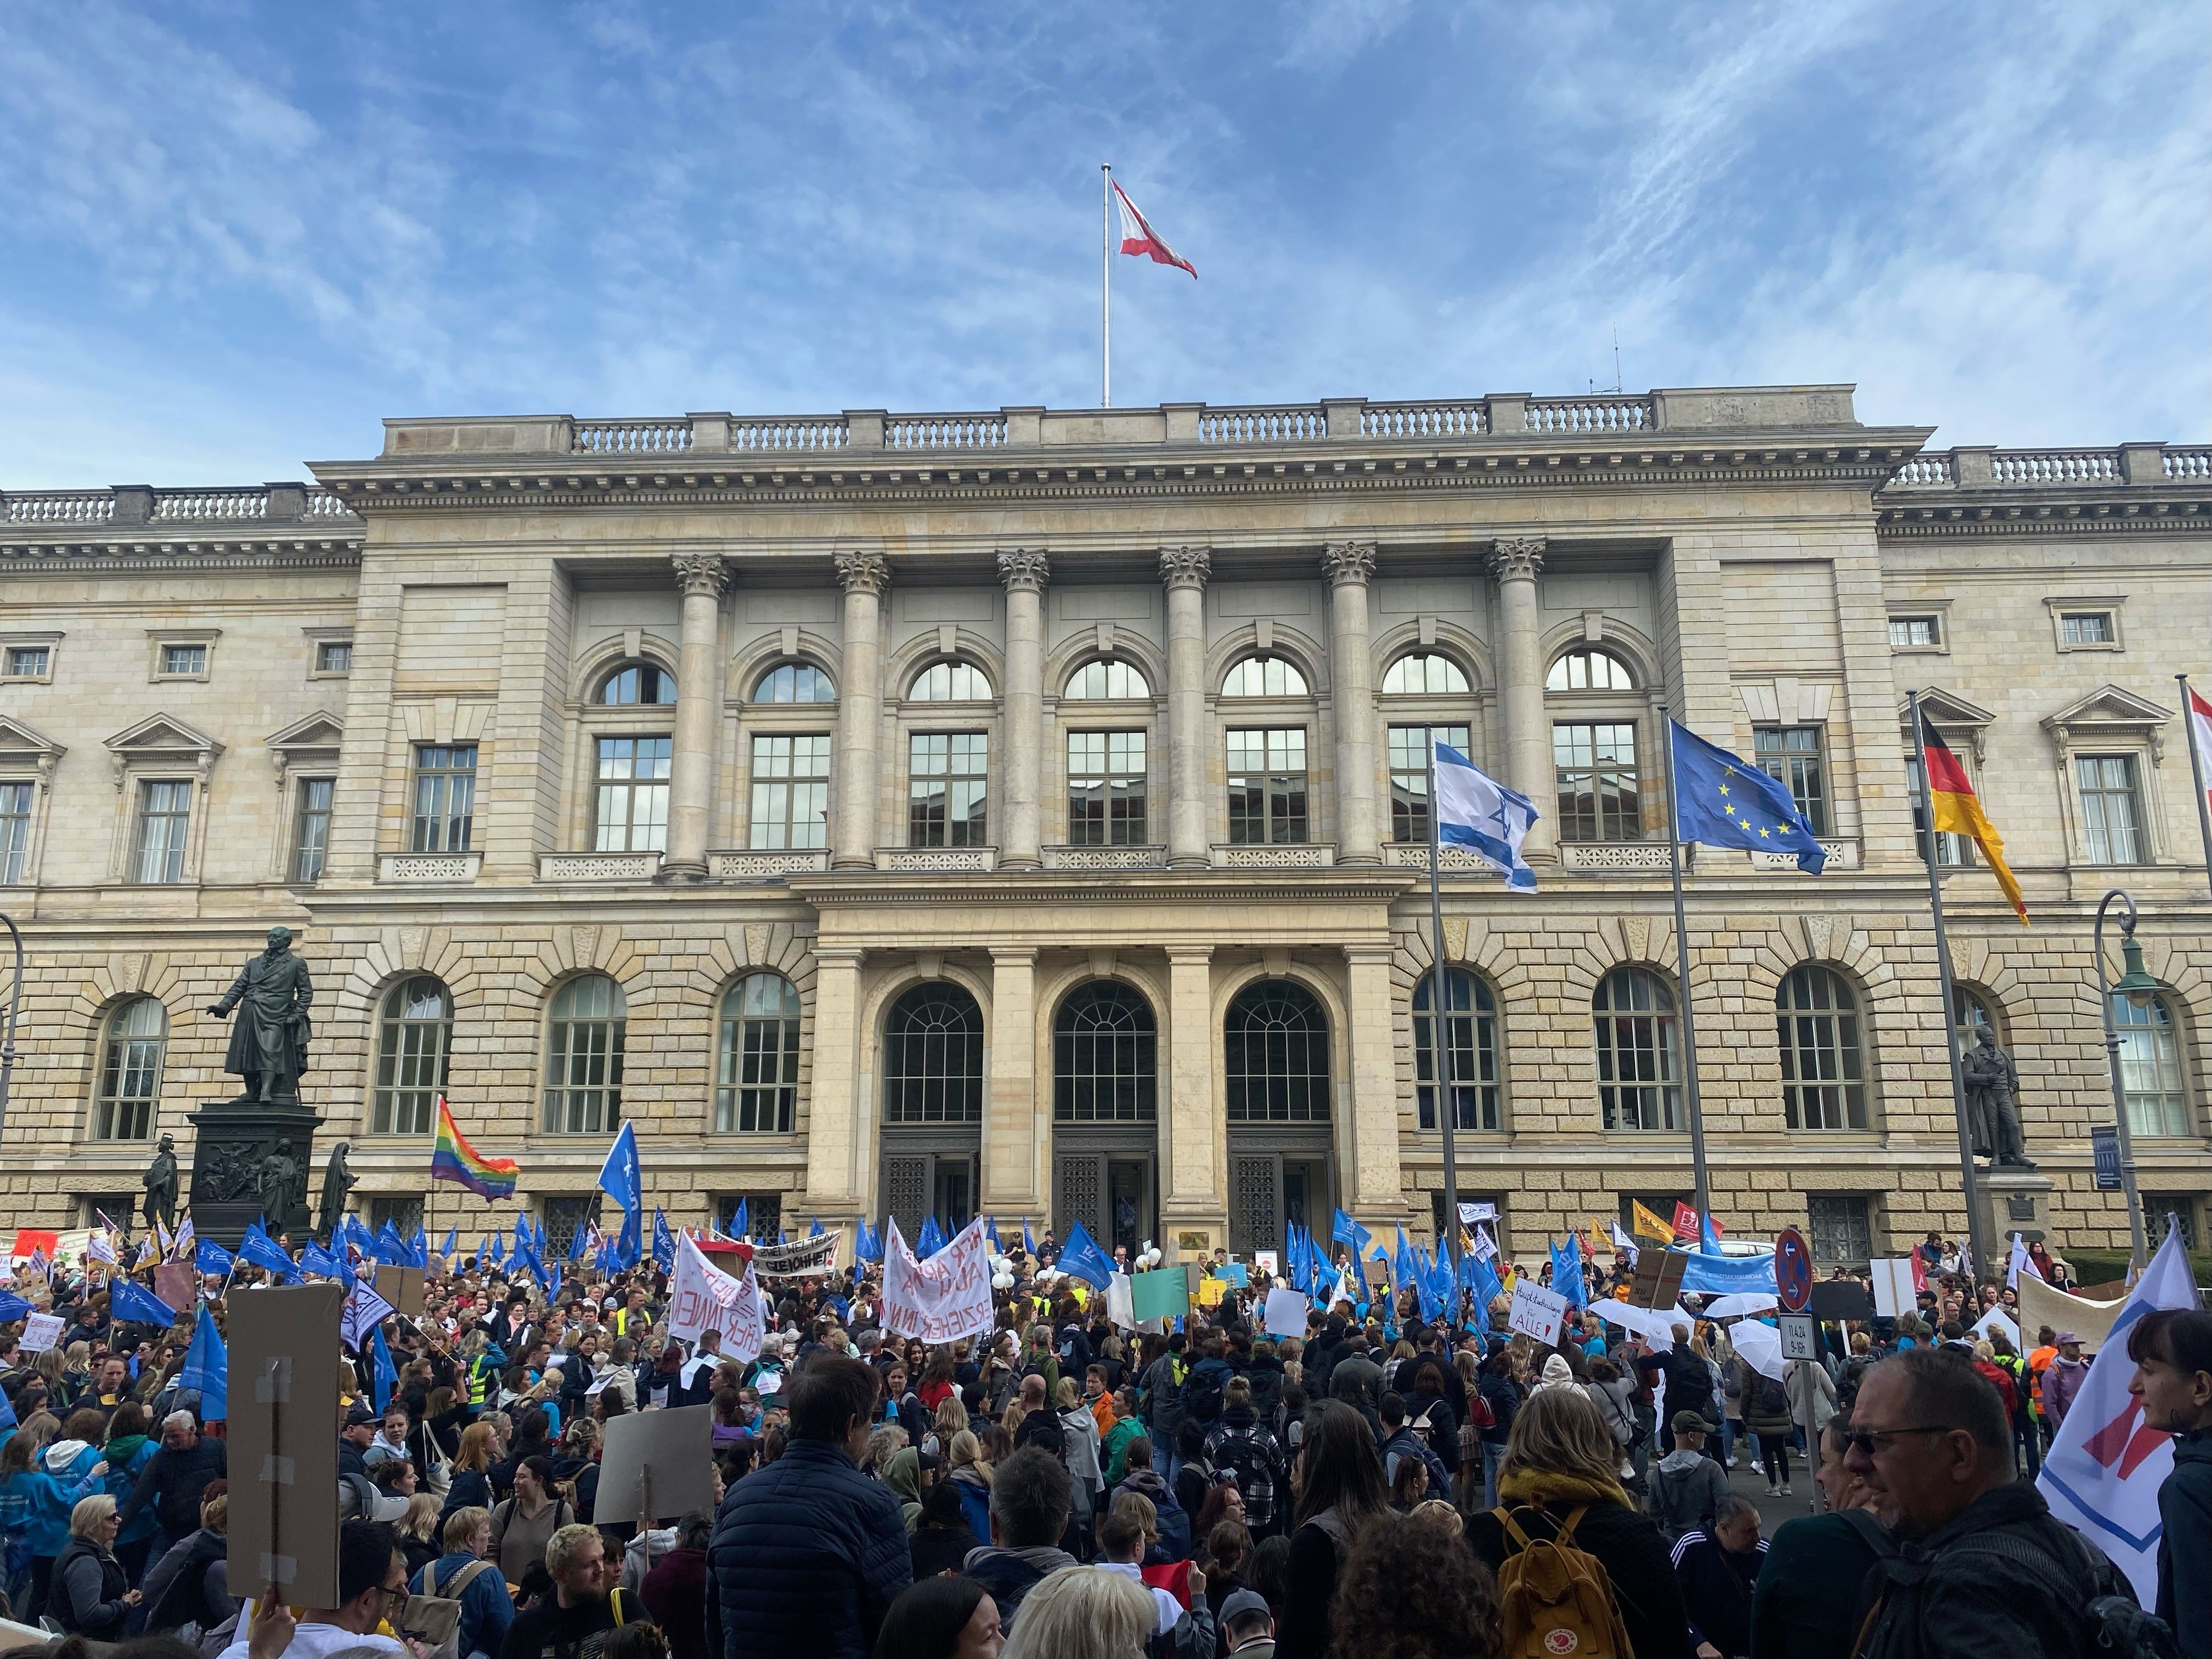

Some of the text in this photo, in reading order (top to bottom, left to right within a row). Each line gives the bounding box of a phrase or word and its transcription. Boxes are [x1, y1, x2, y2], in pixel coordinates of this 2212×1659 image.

[758, 1248, 781, 1257] ZWEI
[787, 1232, 834, 1254] WELTEN
[1516, 1285, 1561, 1318] Hauptstadtzulage
[1527, 1308, 1537, 1317] für
[1791, 1340, 1806, 1355] 9-16h
